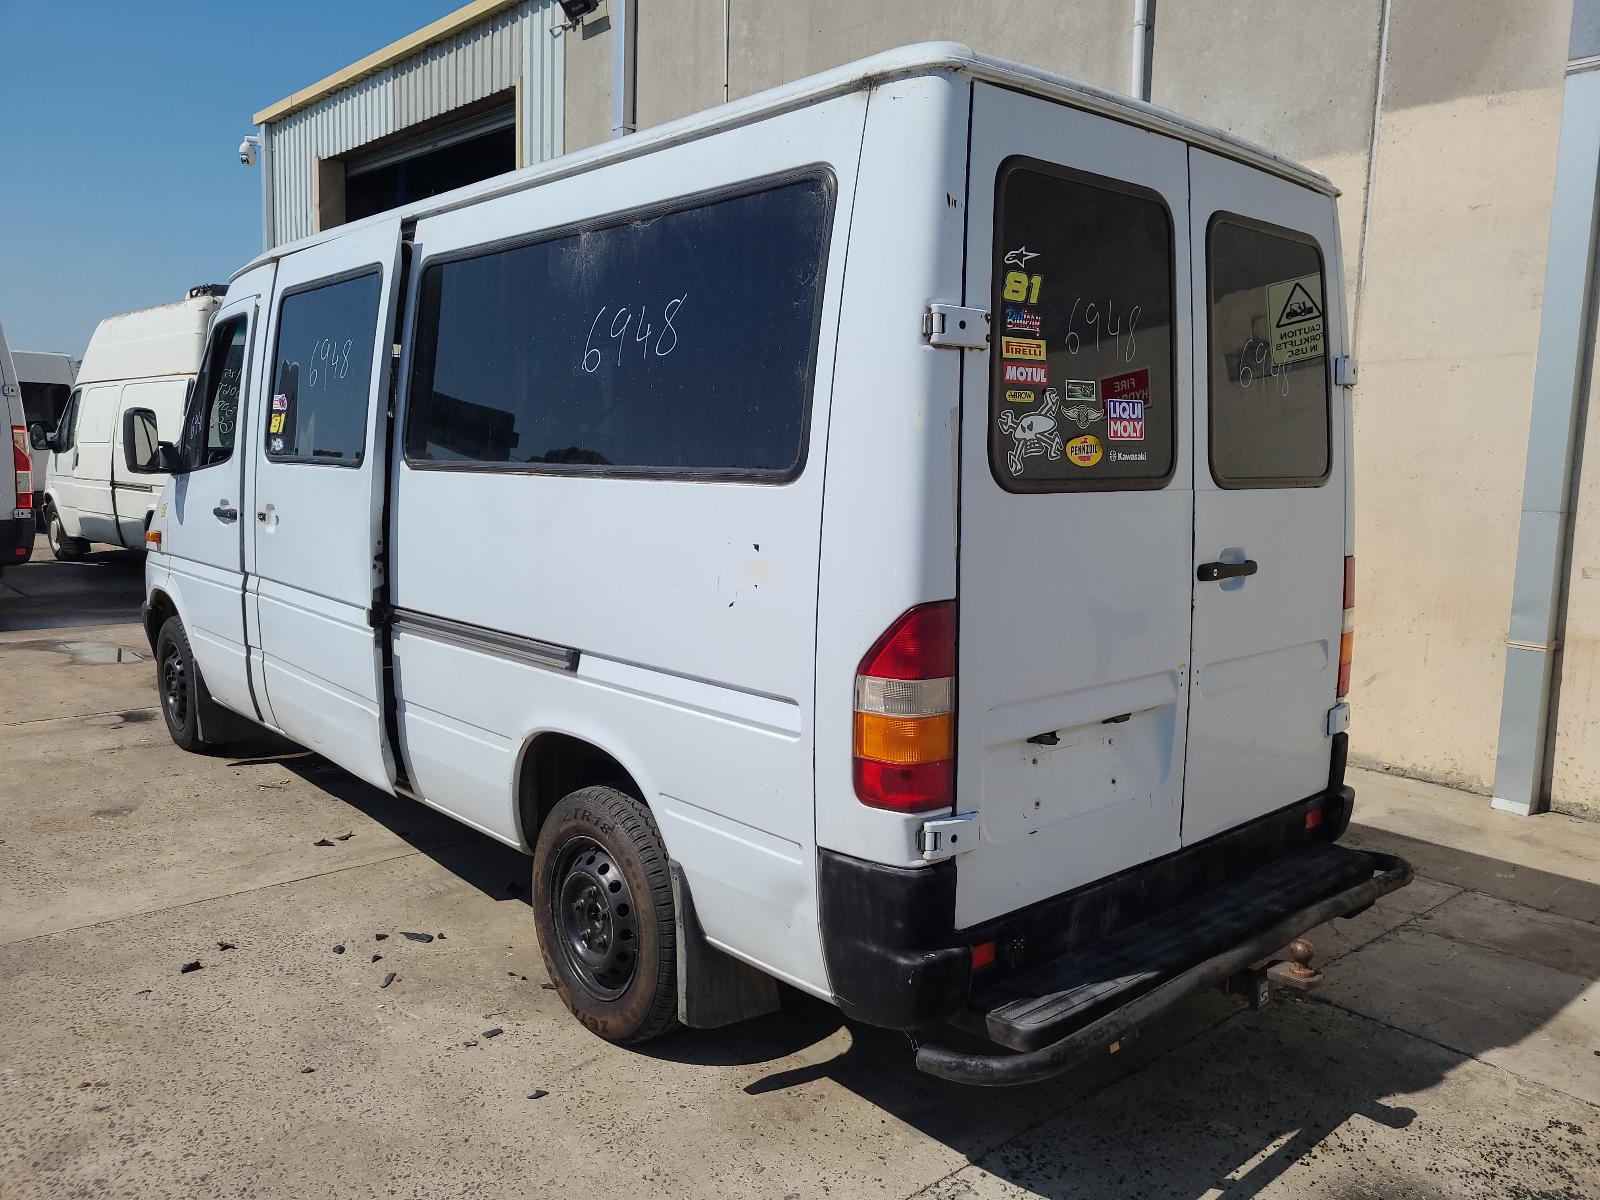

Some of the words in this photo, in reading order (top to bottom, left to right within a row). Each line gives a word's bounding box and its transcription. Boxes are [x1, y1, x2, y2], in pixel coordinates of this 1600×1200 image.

[1003, 272, 1042, 304] 81
[581, 292, 688, 373] 6948
[1065, 297, 1142, 362] 6948
[1005, 341, 1042, 356] PIRELLI
[309, 338, 353, 391] 6948
[1239, 339, 1290, 397] 6948
[1006, 366, 1047, 383] MOTUL
[1110, 402, 1142, 419] LIQUI
[270, 413, 286, 434] 81
[1110, 421, 1143, 437] MOLY
[1070, 443, 1098, 456] PENNZOIL
[1117, 452, 1147, 461] Kawasaki
